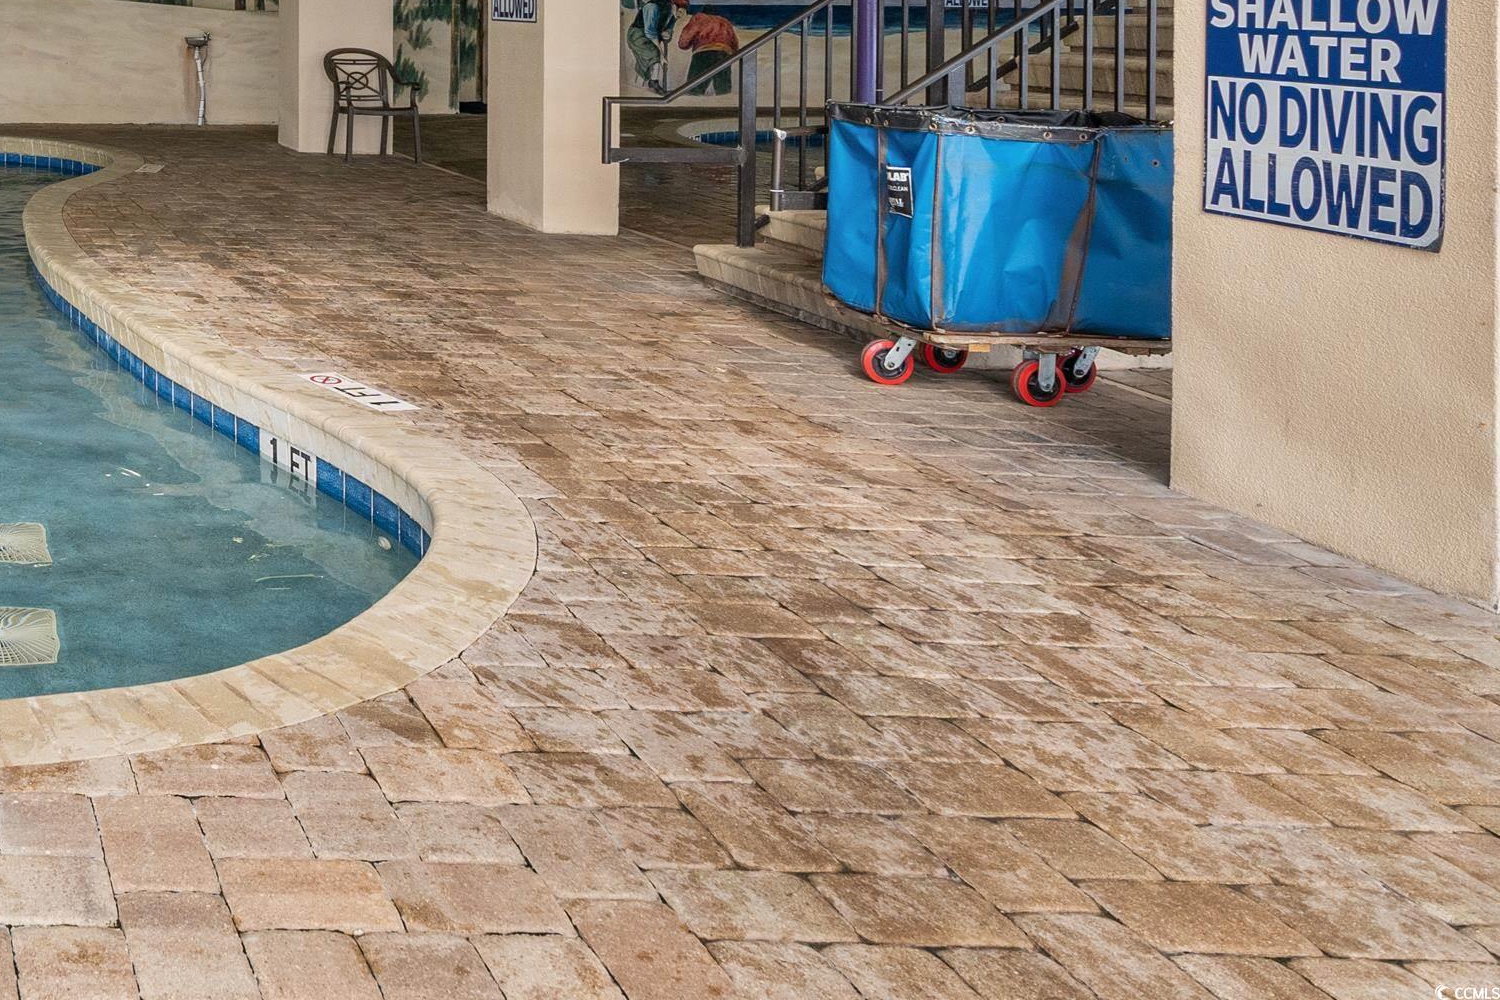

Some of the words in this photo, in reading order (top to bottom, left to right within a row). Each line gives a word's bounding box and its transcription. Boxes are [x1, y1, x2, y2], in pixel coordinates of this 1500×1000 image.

[1238, 33, 1402, 84] WATER
[1210, 80, 1267, 145] NO
[1278, 85, 1438, 166] DIVING
[1210, 147, 1433, 239] ALLOWED
[333, 386, 382, 398] FT
[269, 437, 278, 464] 1
[290, 446, 312, 481] FT
